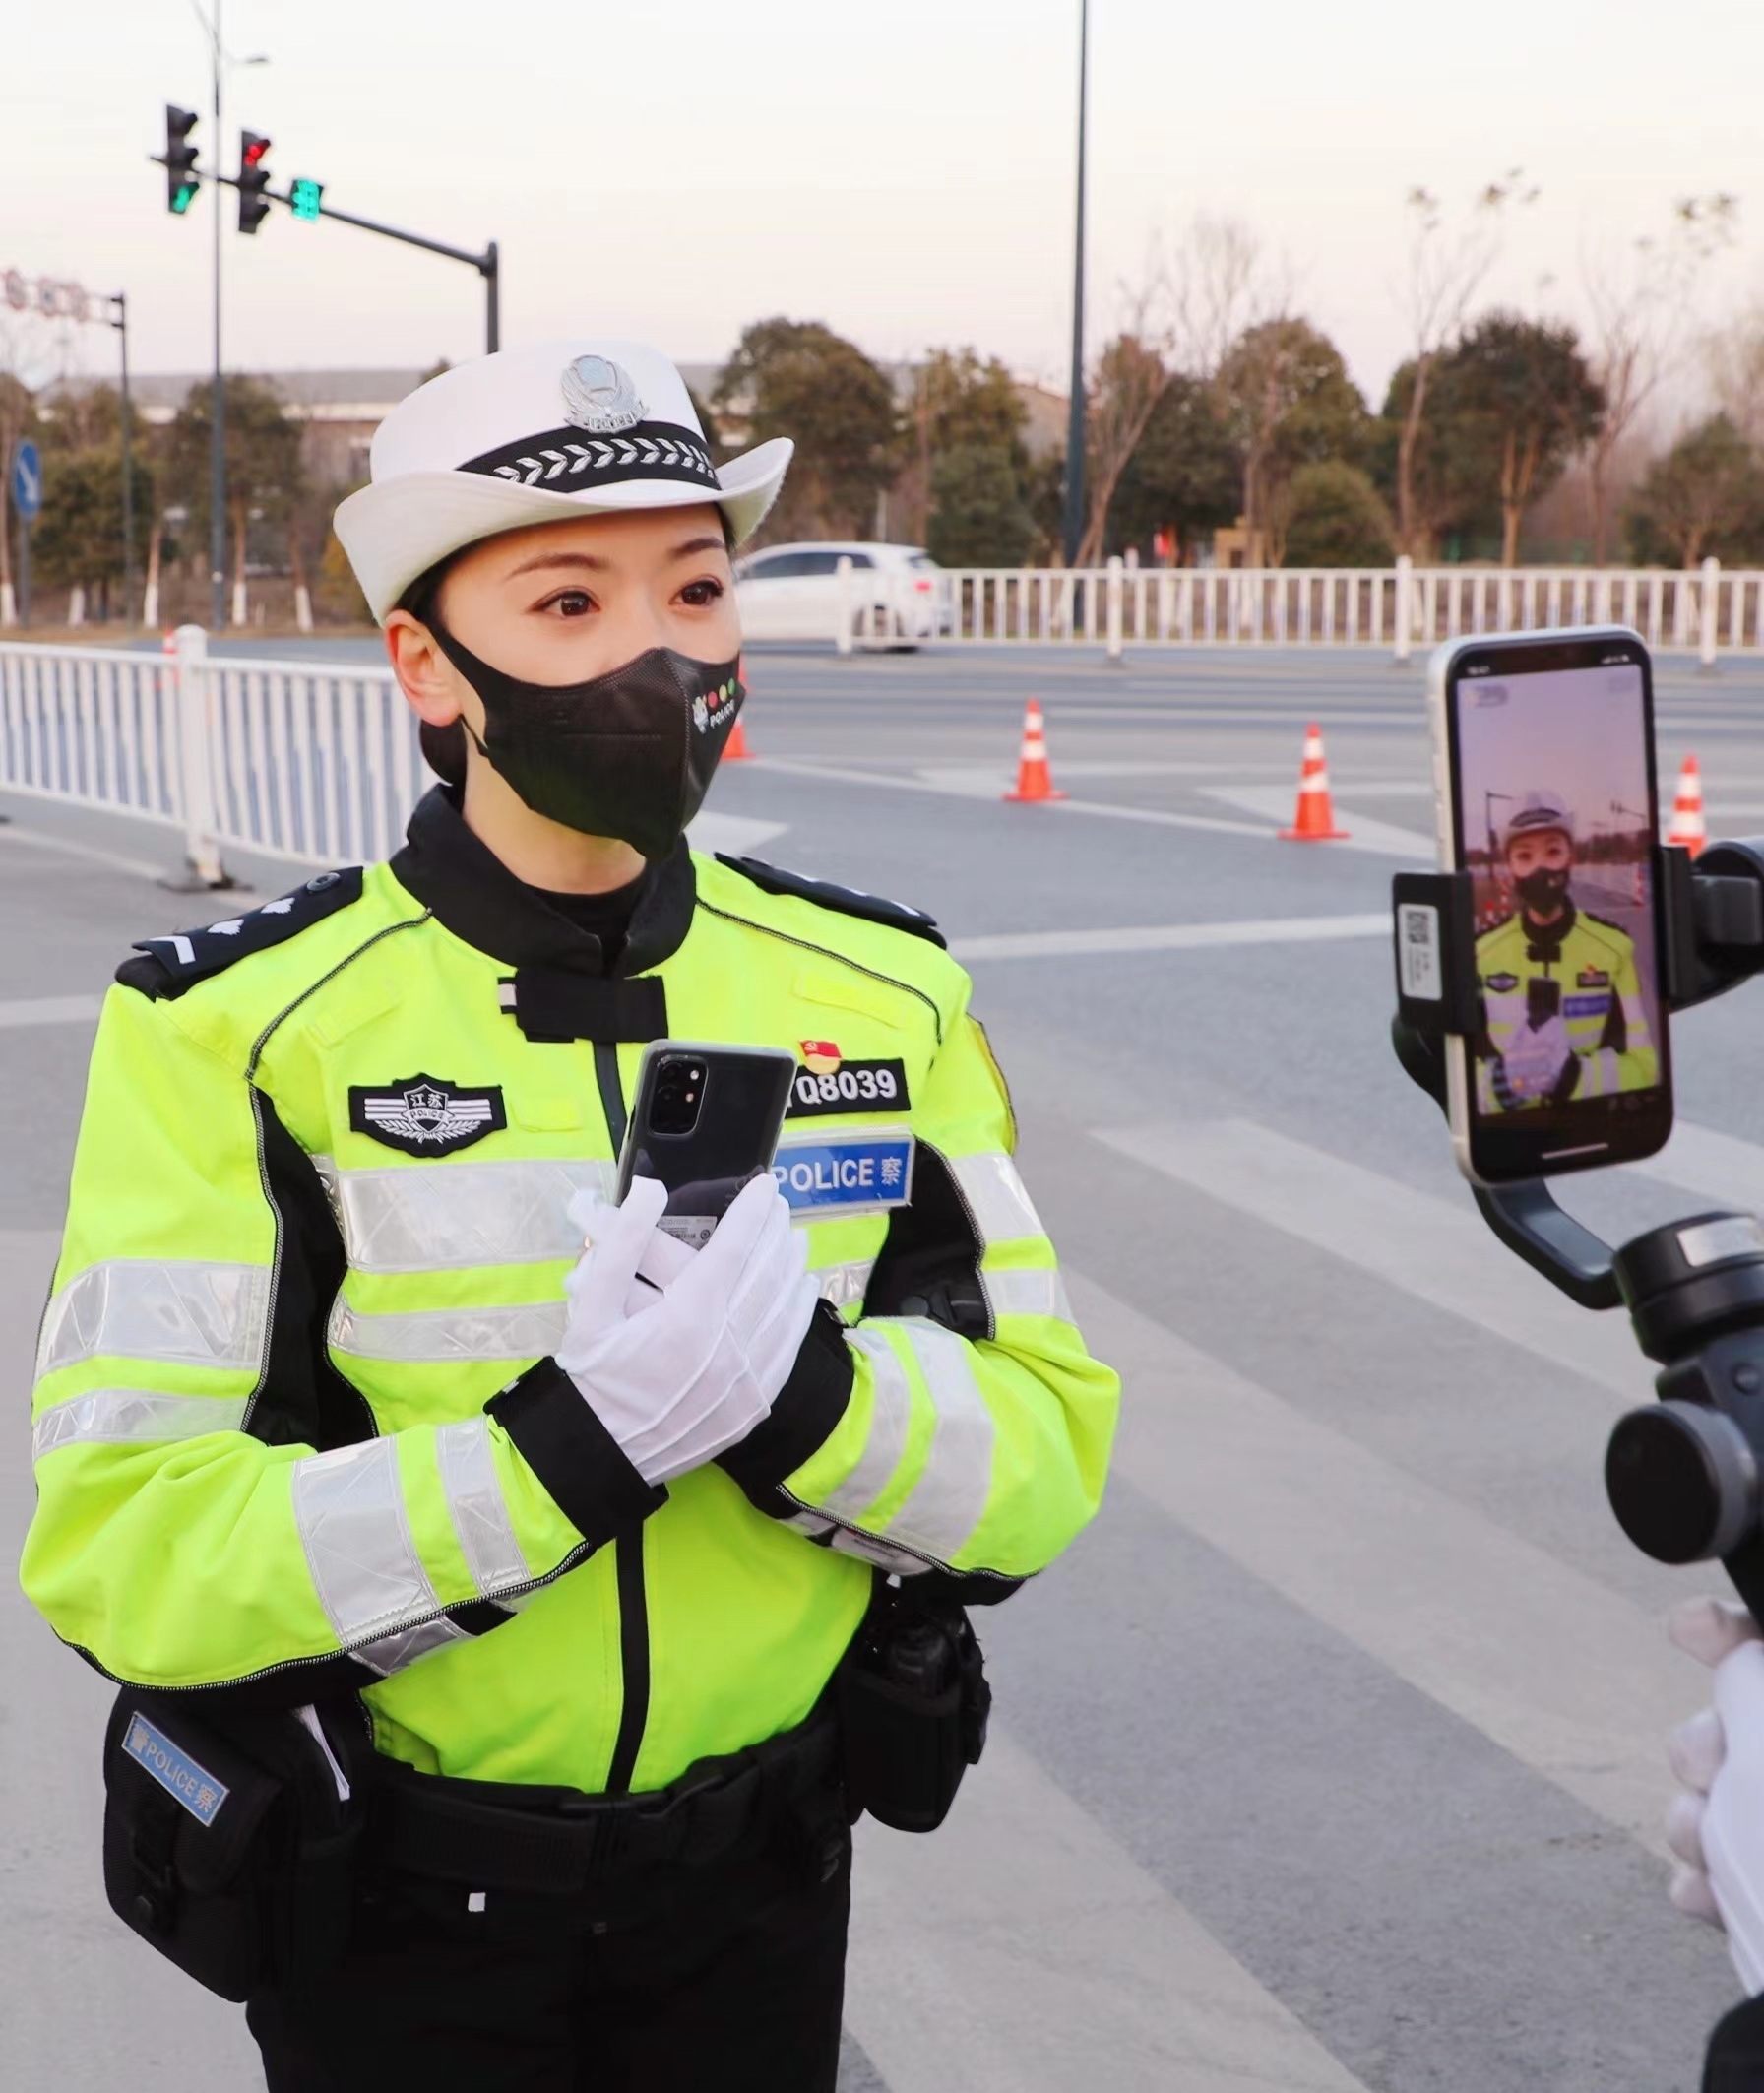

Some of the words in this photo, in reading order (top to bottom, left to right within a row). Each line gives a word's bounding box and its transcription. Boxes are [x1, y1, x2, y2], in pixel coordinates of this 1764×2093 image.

[710, 699, 735, 729] POLICE
[410, 1093, 443, 1108] 江苏
[788, 1069, 897, 1107] Q8039
[410, 1110, 444, 1119] POLICE
[881, 1157, 902, 1185] 察
[145, 1740, 198, 1797] POLICE
[193, 1783, 217, 1812] 察
